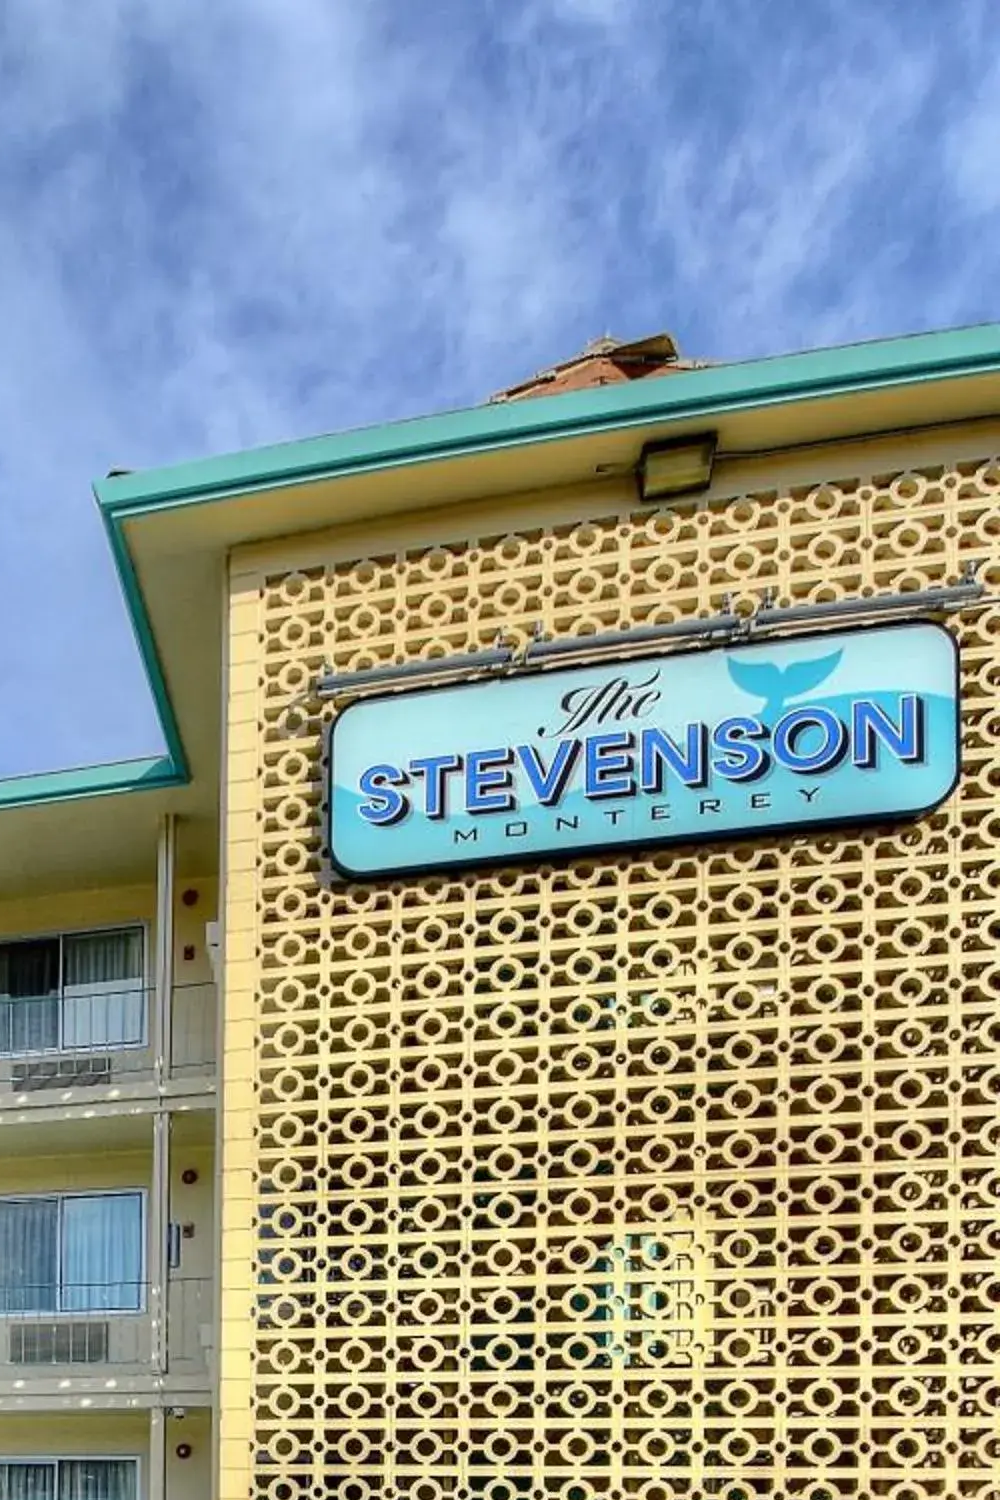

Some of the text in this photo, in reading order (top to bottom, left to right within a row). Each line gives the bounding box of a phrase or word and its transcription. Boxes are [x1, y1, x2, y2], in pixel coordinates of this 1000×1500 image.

[537, 668, 662, 738] The
[357, 692, 928, 826] STEVENSON
[453, 787, 821, 843] MONTEREY
